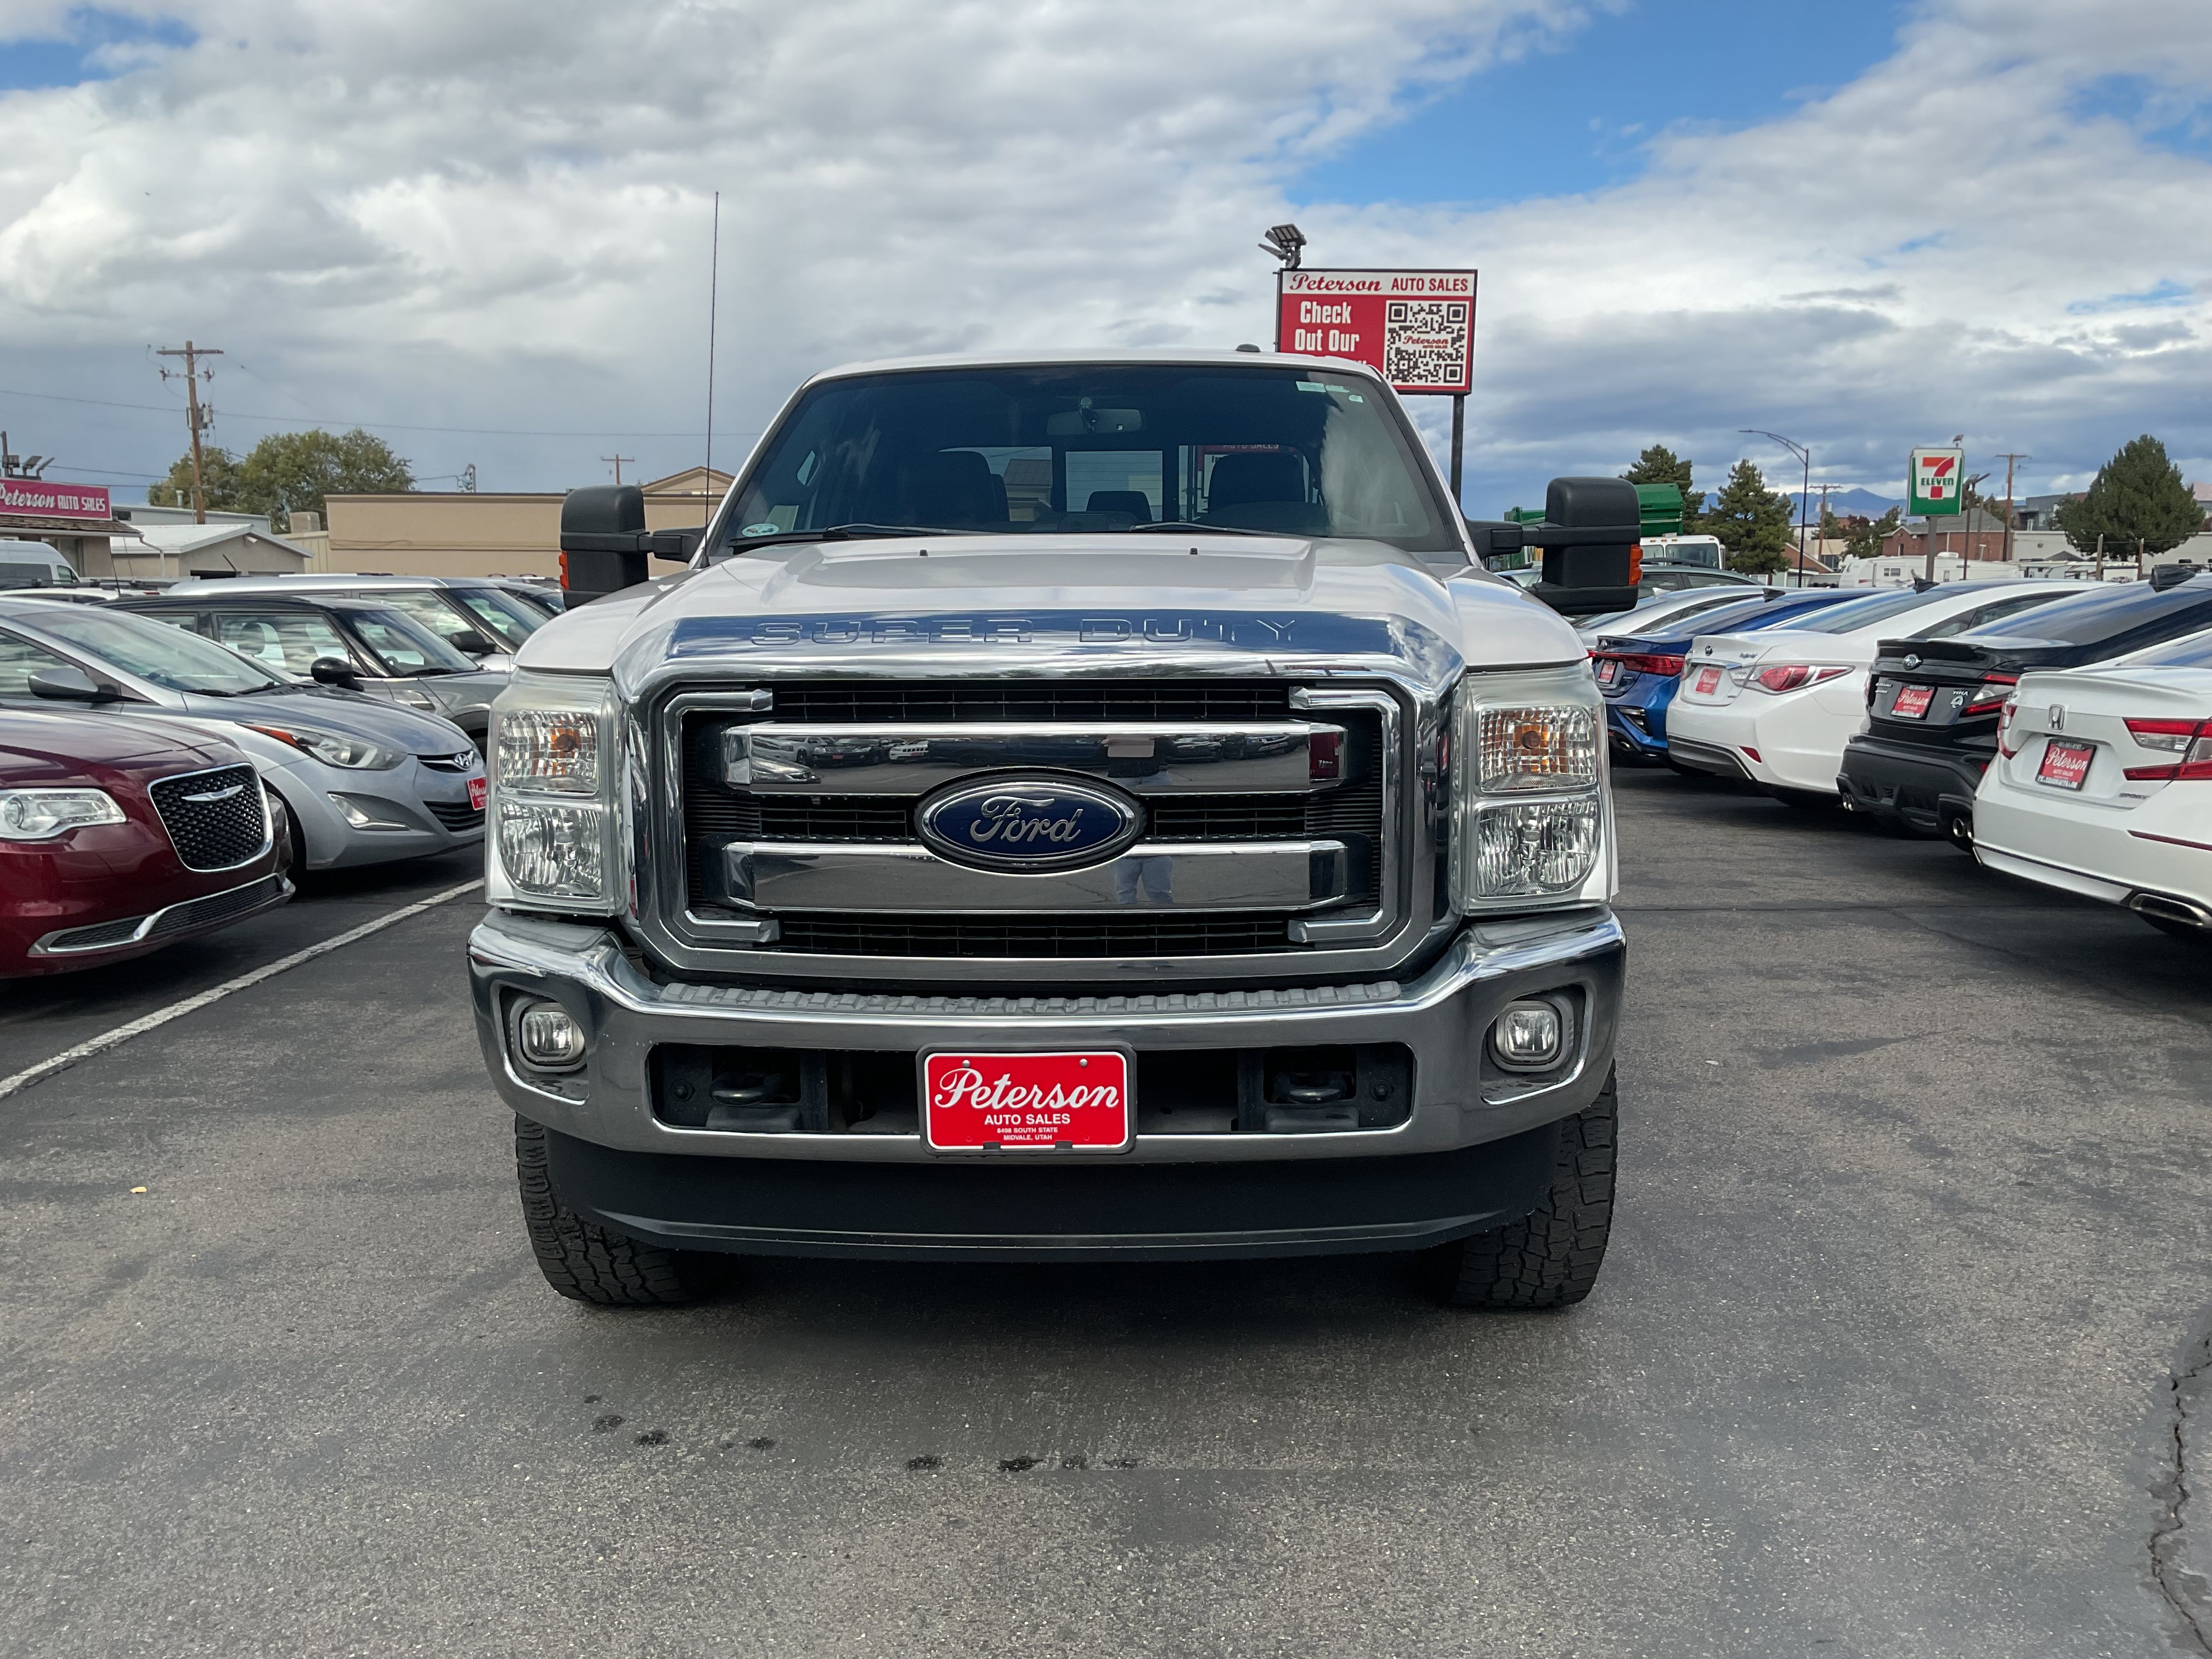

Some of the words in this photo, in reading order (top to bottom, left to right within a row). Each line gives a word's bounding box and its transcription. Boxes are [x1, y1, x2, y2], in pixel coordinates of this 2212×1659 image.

[1289, 273, 1382, 291] Peterson
[1391, 278, 1425, 291] AUTO
[1429, 278, 1468, 291] SALES
[1300, 301, 1352, 324] Check
[1295, 329, 1323, 351] Out
[1329, 330, 1360, 352] Our
[1403, 335, 1449, 344] Peterson
[1922, 456, 1954, 498] 7
[58, 495, 79, 510] AUTO
[82, 497, 105, 511] SALES
[751, 619, 1033, 645] SUPER
[1079, 618, 1296, 642] DUTY
[1898, 690, 1929, 706] Peterson
[2045, 747, 2088, 771] Peterson
[970, 795, 1084, 843] Ford
[934, 1068, 1120, 1110] Peterson
[984, 1114, 1021, 1125] AUTO
[1026, 1113, 1070, 1124] SALES
